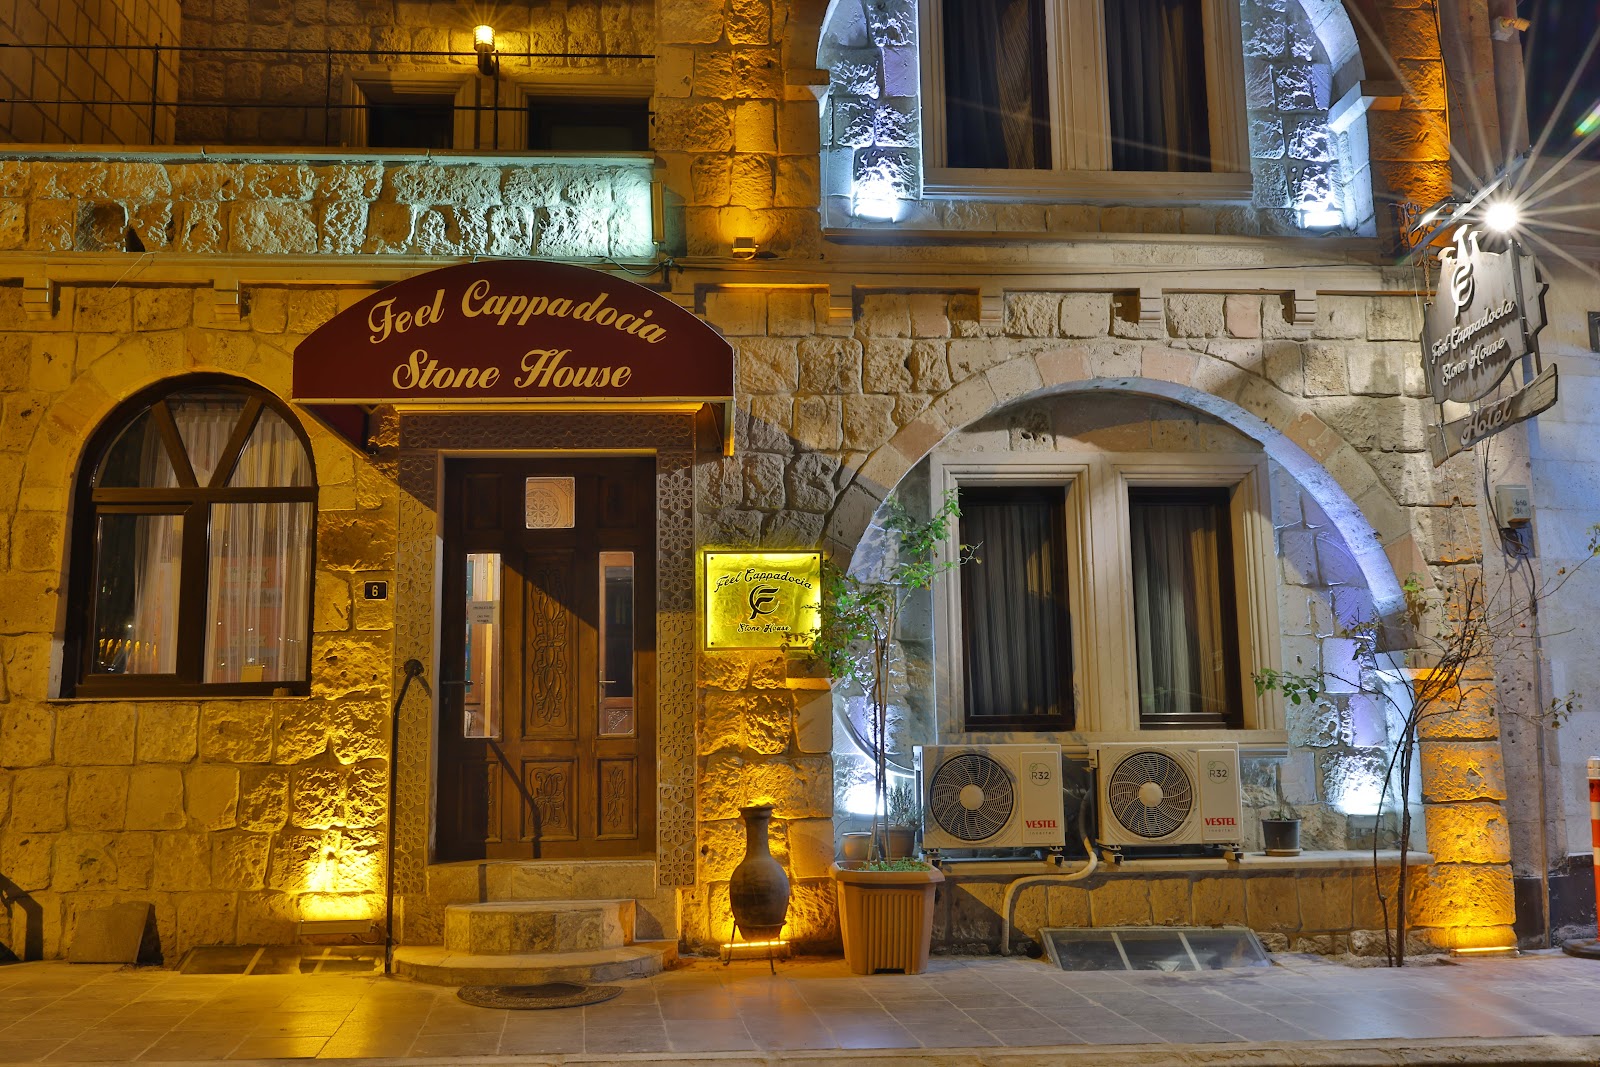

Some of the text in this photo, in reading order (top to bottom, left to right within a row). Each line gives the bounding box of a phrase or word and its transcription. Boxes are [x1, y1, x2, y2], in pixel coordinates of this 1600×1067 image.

[368, 279, 668, 344] Feel Cappadocia
[1431, 299, 1515, 364] Feel Cappadocia
[392, 348, 632, 389] Stone House
[1442, 337, 1506, 386] Stone House
[1460, 398, 1513, 446] Hotel
[713, 568, 813, 593] Feel Cappadocia
[372, 585, 379, 597] 6
[737, 623, 791, 634] Stone House
[1031, 771, 1050, 780] R32
[1209, 769, 1228, 778] R32
[1025, 819, 1058, 829] VESTEL
[1204, 817, 1237, 826] VESTEL
